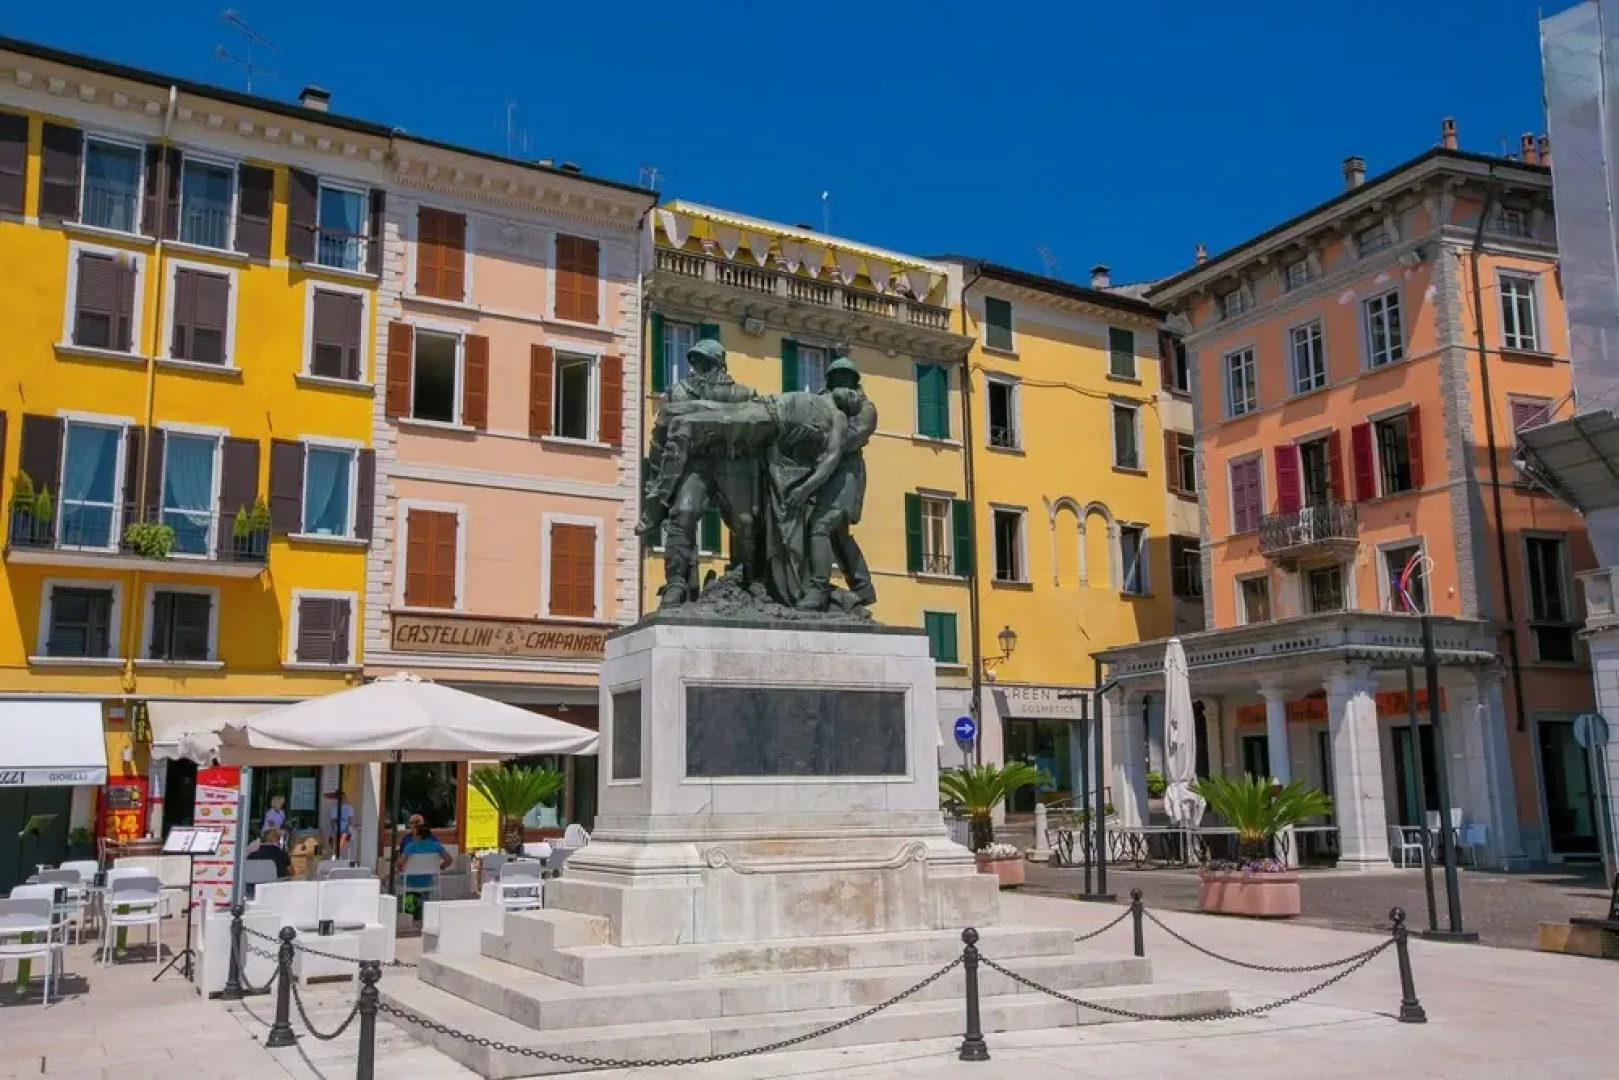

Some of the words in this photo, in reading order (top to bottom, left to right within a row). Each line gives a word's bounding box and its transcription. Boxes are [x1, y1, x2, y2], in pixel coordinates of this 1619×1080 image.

[396, 624, 494, 647] CASTELLINI
[504, 631, 514, 645] &
[0, 771, 25, 784] ZZI
